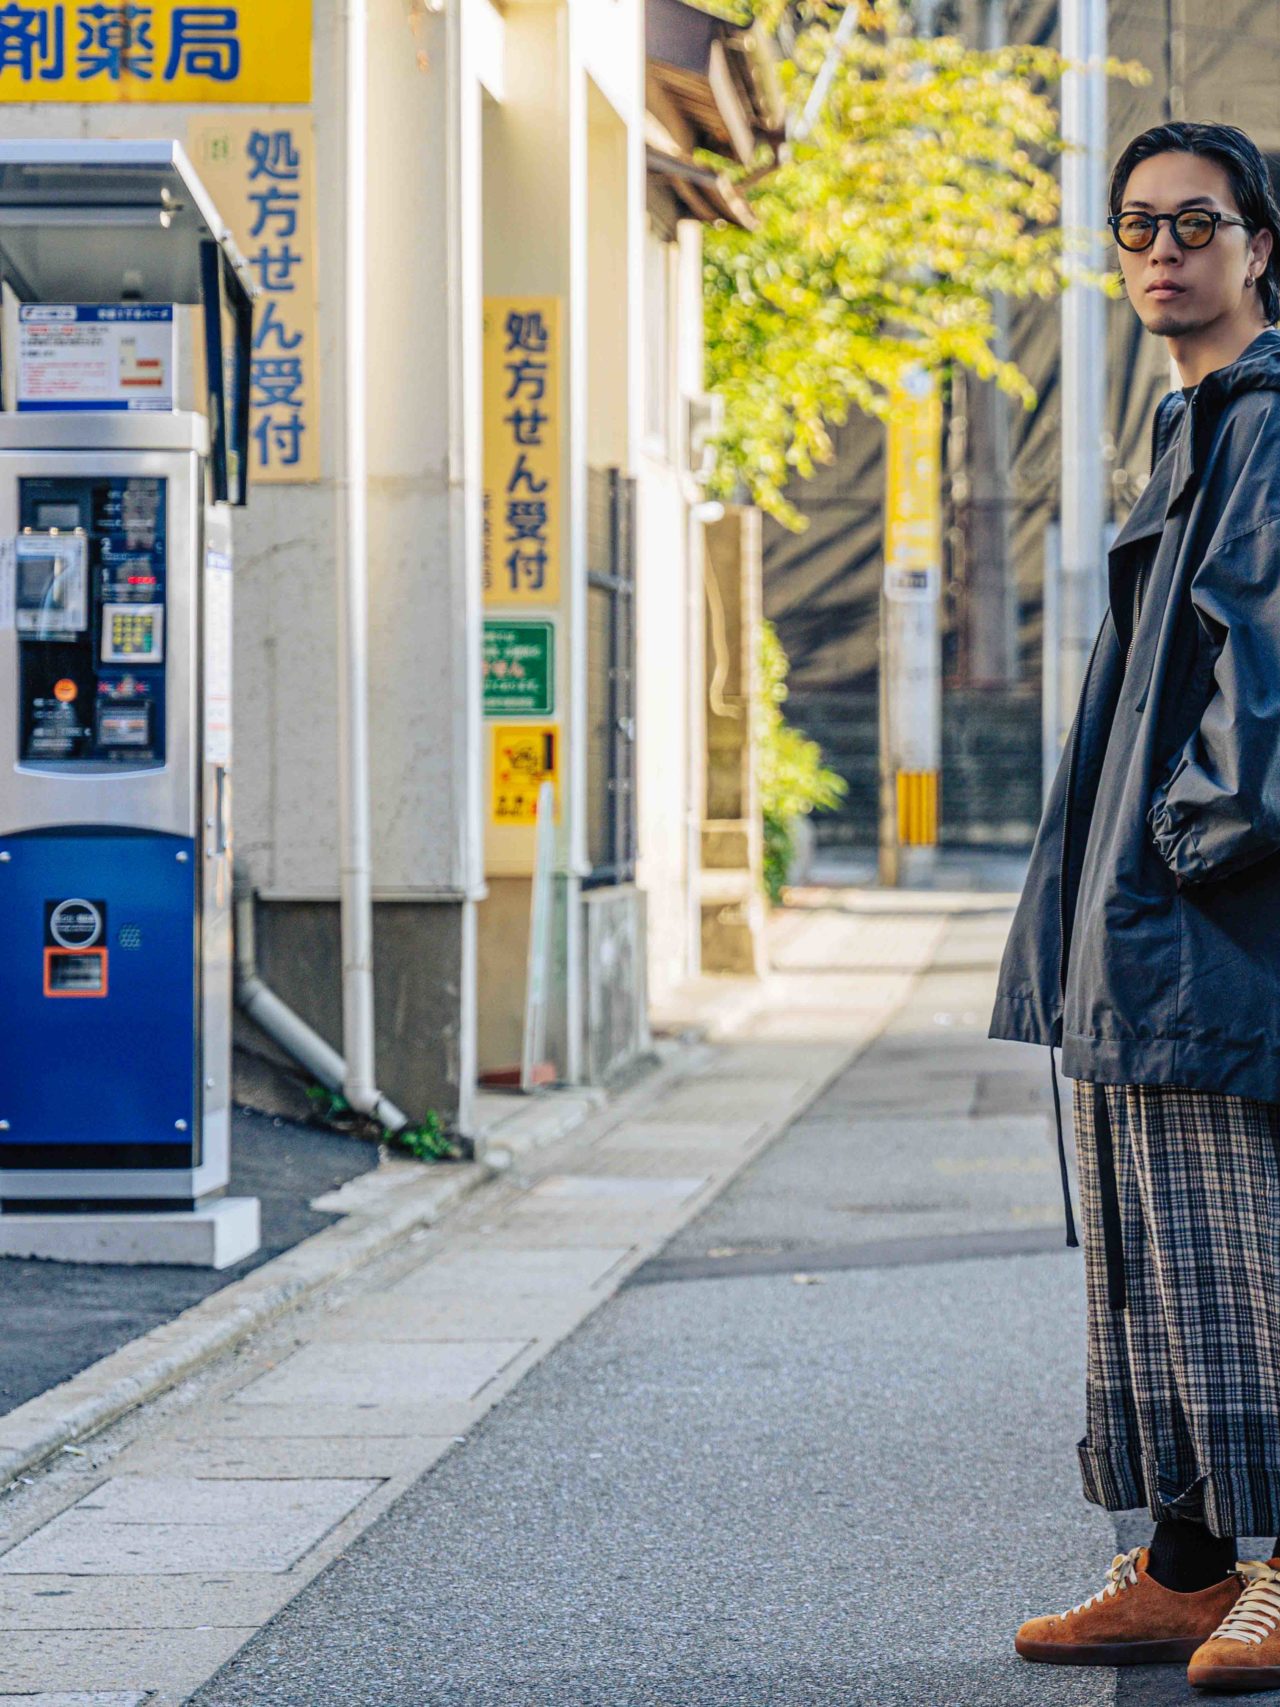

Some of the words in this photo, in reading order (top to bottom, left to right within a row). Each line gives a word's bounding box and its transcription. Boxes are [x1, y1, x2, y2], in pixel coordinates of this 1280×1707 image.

[0, 4, 241, 81] 剤薬局
[246, 129, 305, 466] 処方せん受付
[504, 310, 547, 590] 処方せん受付
